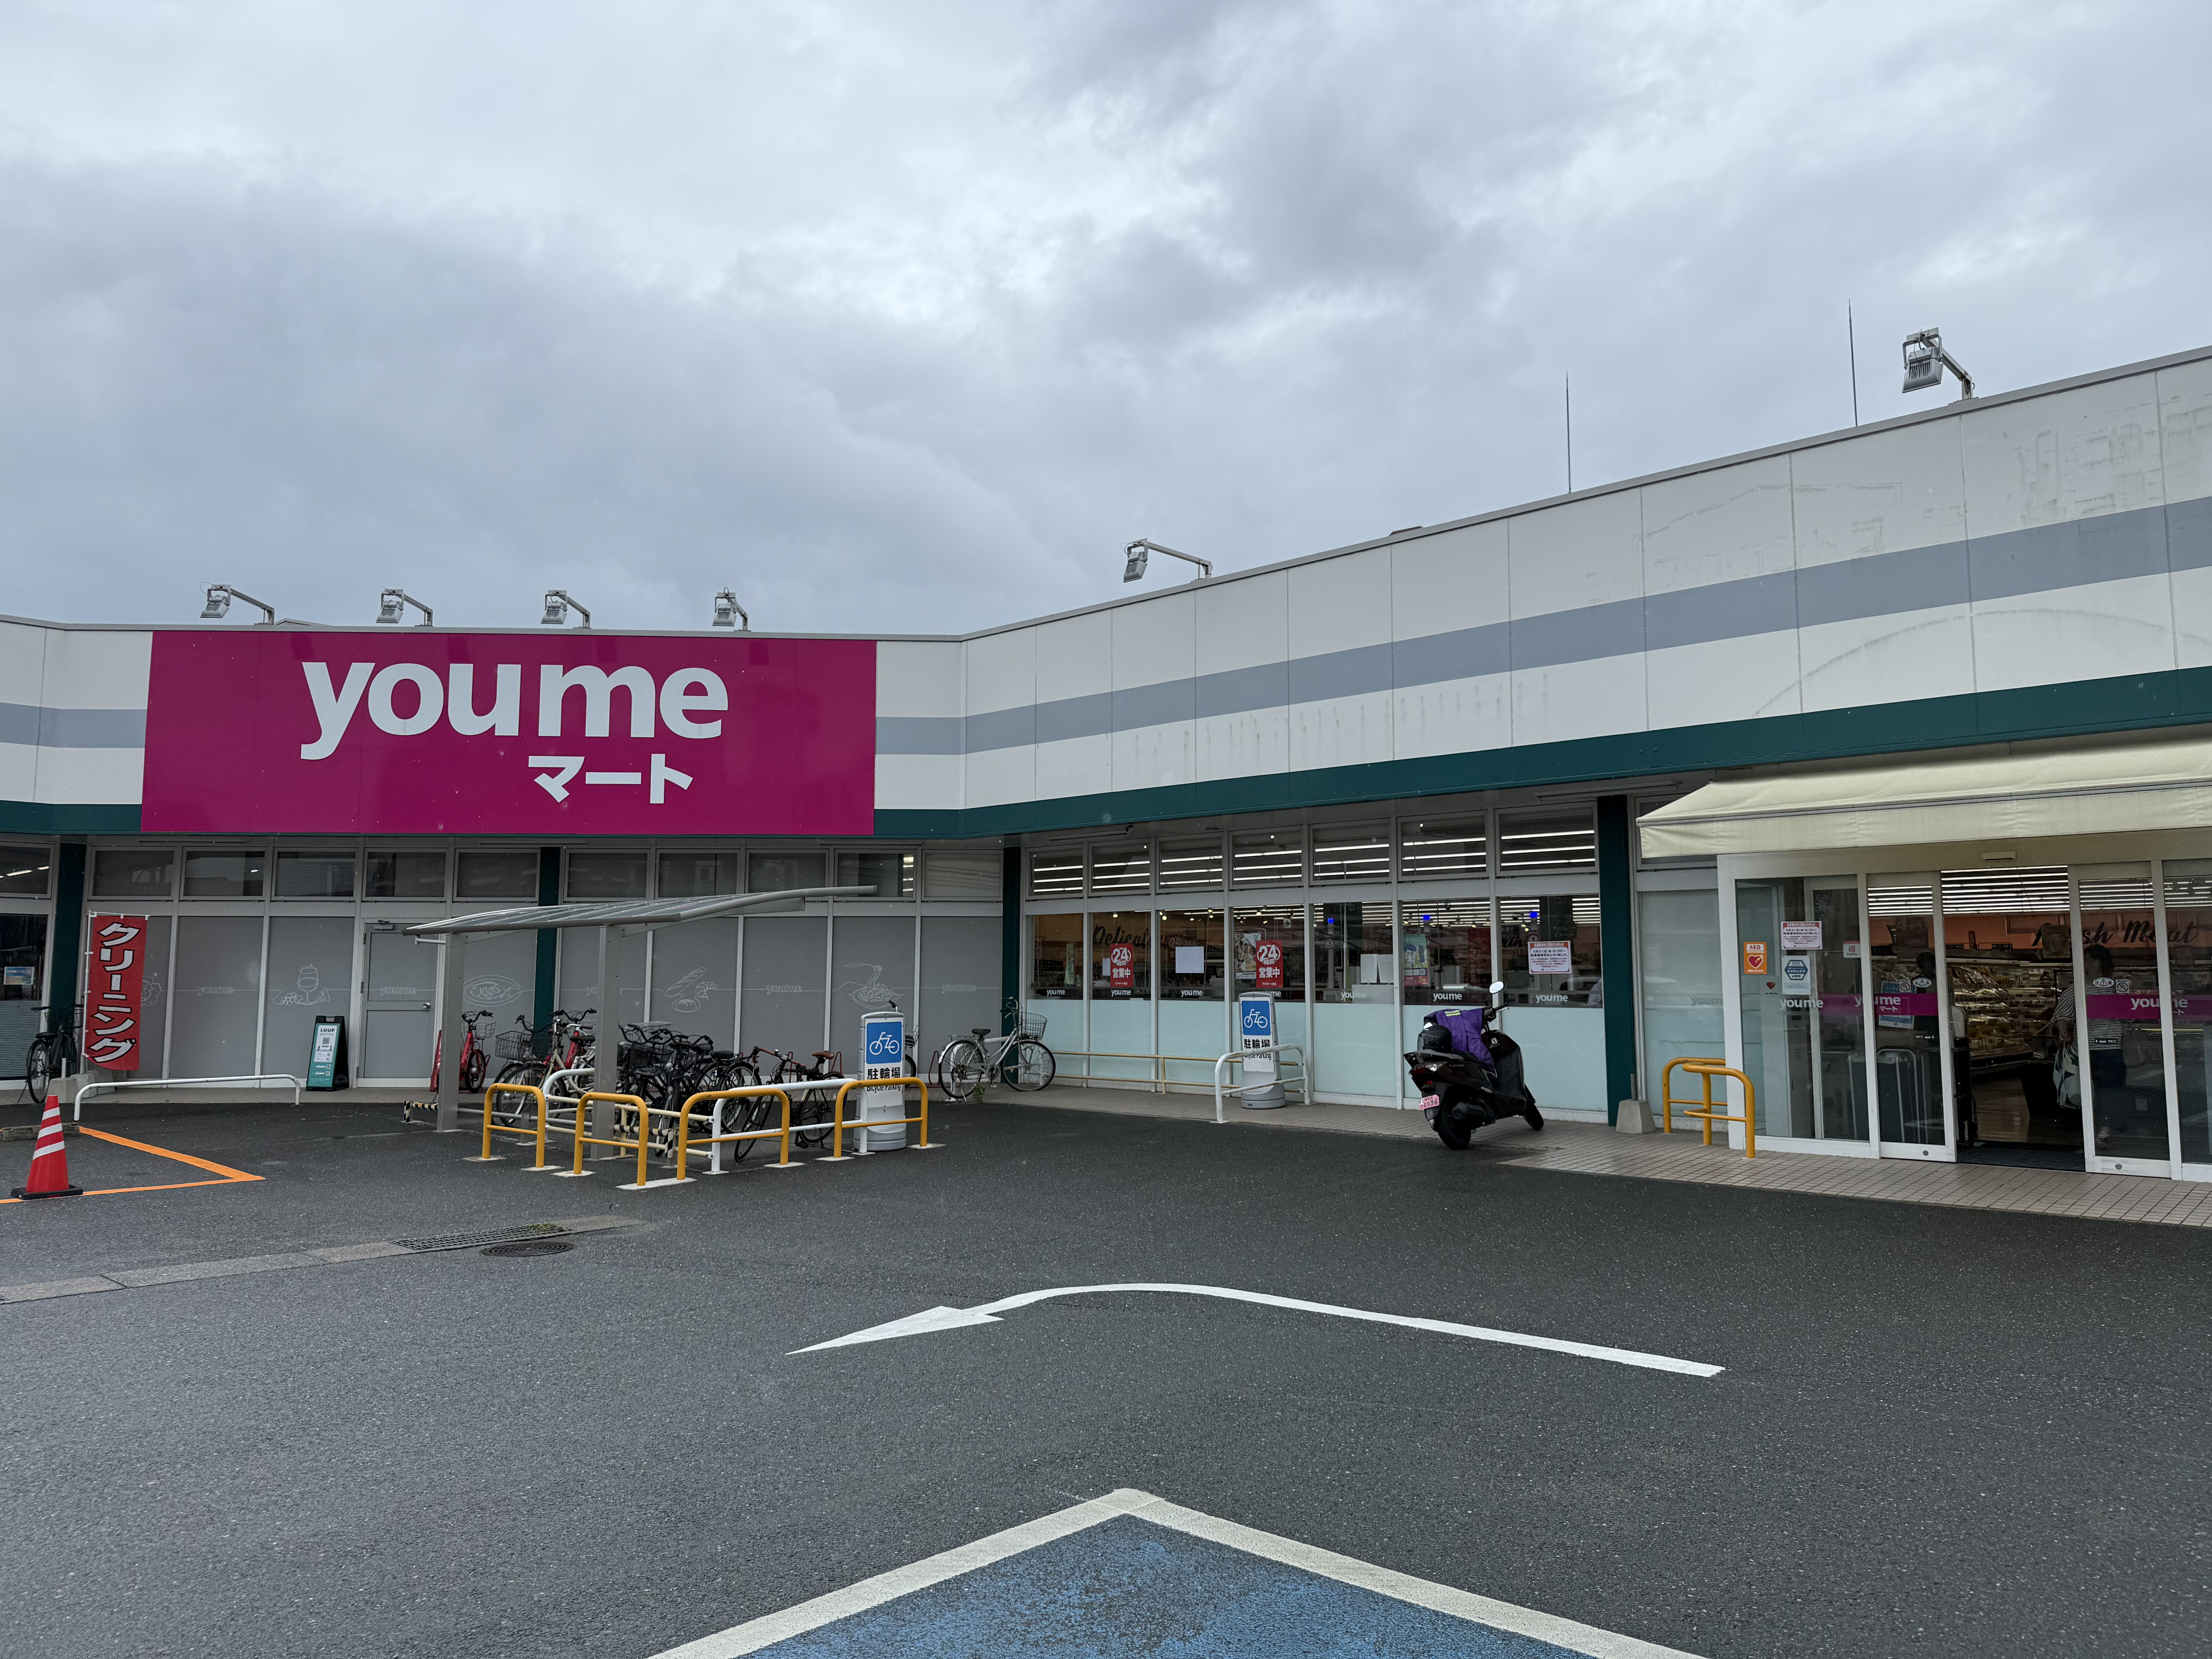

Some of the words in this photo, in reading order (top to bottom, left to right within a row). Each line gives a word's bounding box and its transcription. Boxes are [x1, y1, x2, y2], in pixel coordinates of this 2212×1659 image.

[301, 661, 729, 760] youme
[528, 753, 694, 804] マート
[1113, 947, 1129, 963] 24
[1259, 945, 1278, 962] 24
[1113, 968, 1131, 978] 営業中
[1259, 967, 1280, 979] 営業中
[89, 921, 141, 1063] クリーニング
[380, 987, 416, 996] youme
[767, 986, 802, 994] youme
[1341, 991, 1367, 1000] youme
[1433, 993, 1462, 1002] youme
[1536, 994, 1568, 1003] youme
[1854, 996, 1901, 1007] yme
[1780, 998, 1824, 1010] youme
[1244, 1039, 1271, 1049] 駐輪場
[867, 1067, 901, 1080] 駐輪場
